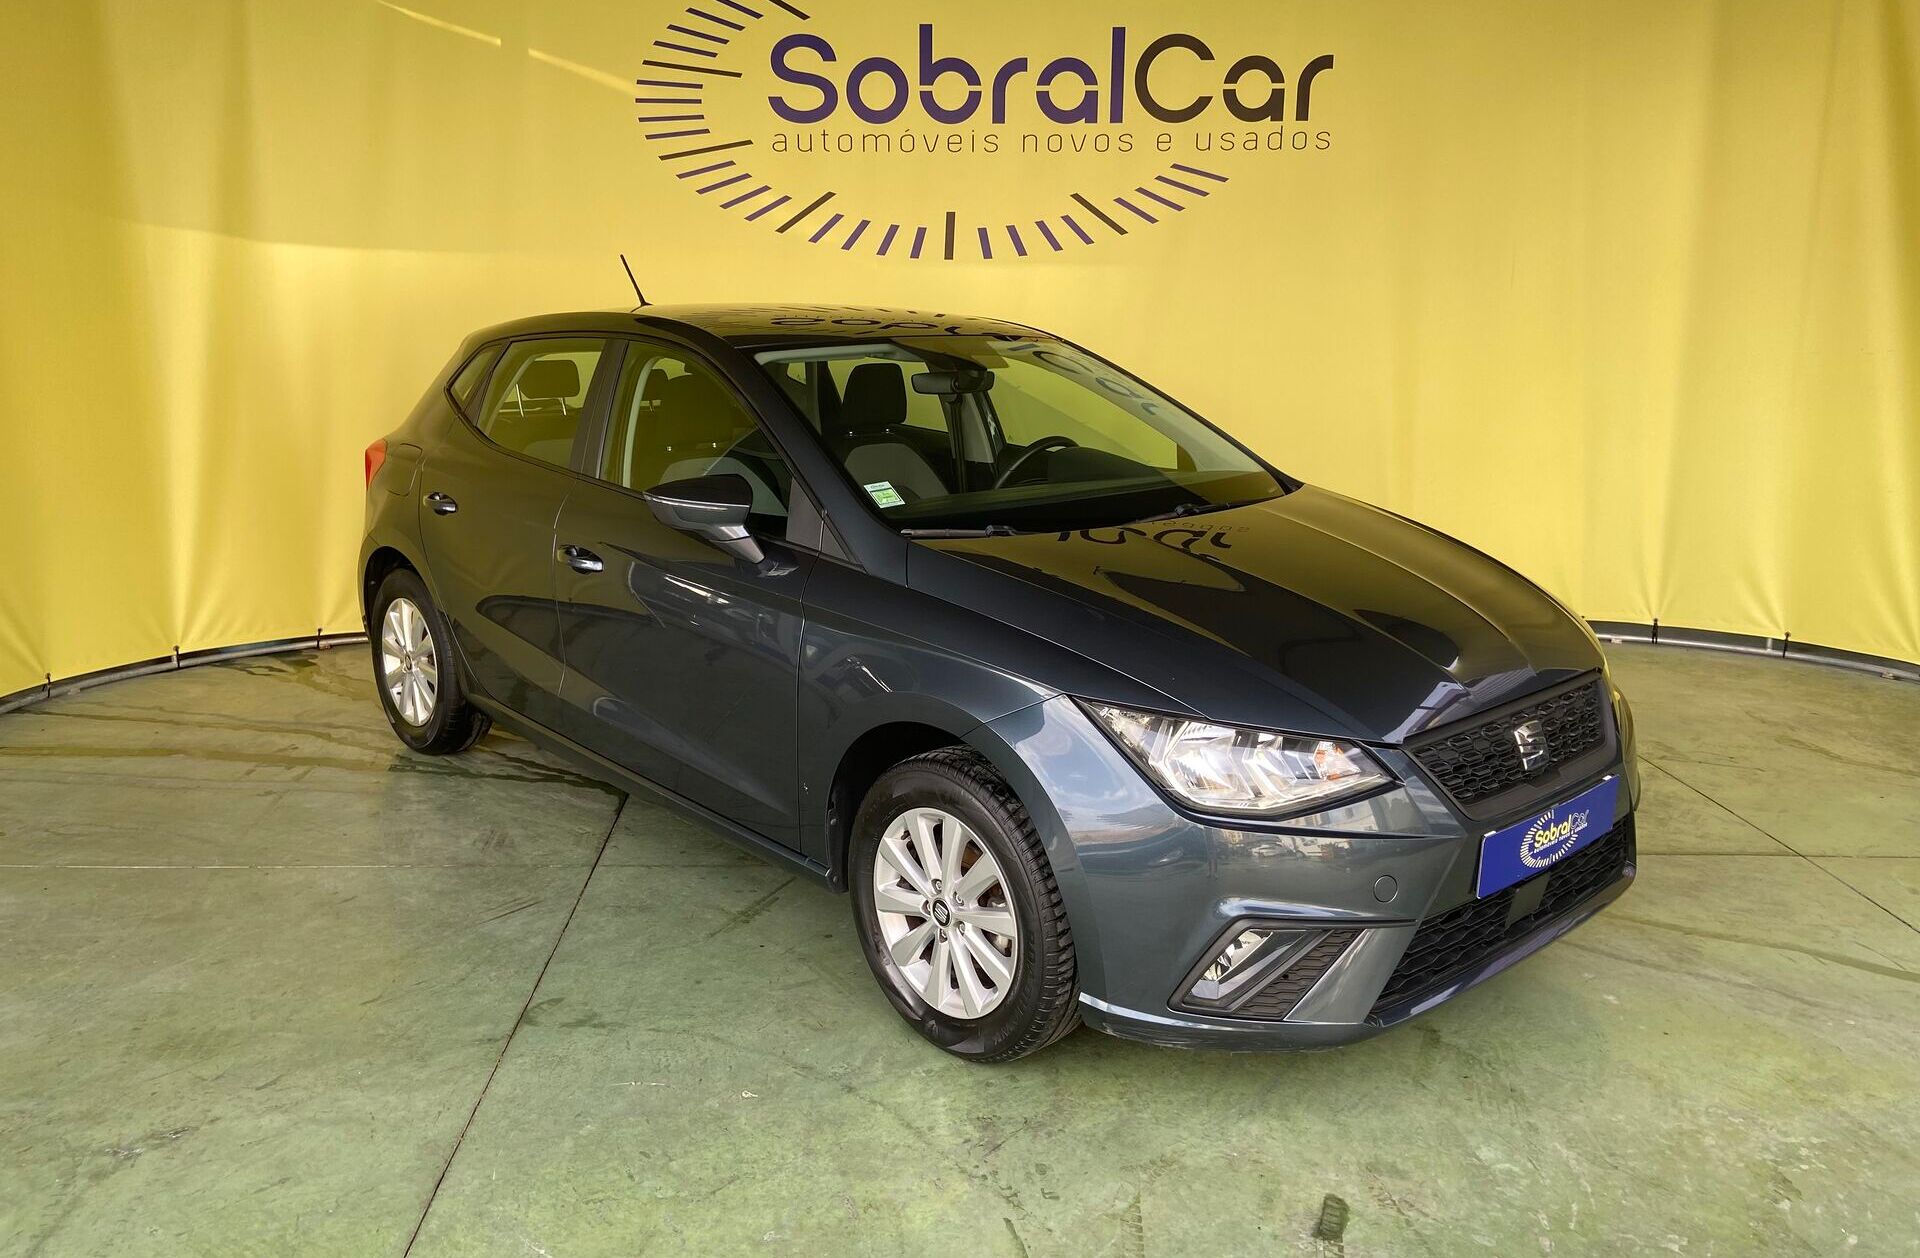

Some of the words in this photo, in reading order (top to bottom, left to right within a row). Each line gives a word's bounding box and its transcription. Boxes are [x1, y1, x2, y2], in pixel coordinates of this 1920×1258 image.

[768, 24, 1334, 124] SobralCar
[772, 129, 998, 153] automóveis
[1022, 131, 1133, 153] novos
[1156, 131, 1171, 152] e
[1196, 126, 1330, 151] usados
